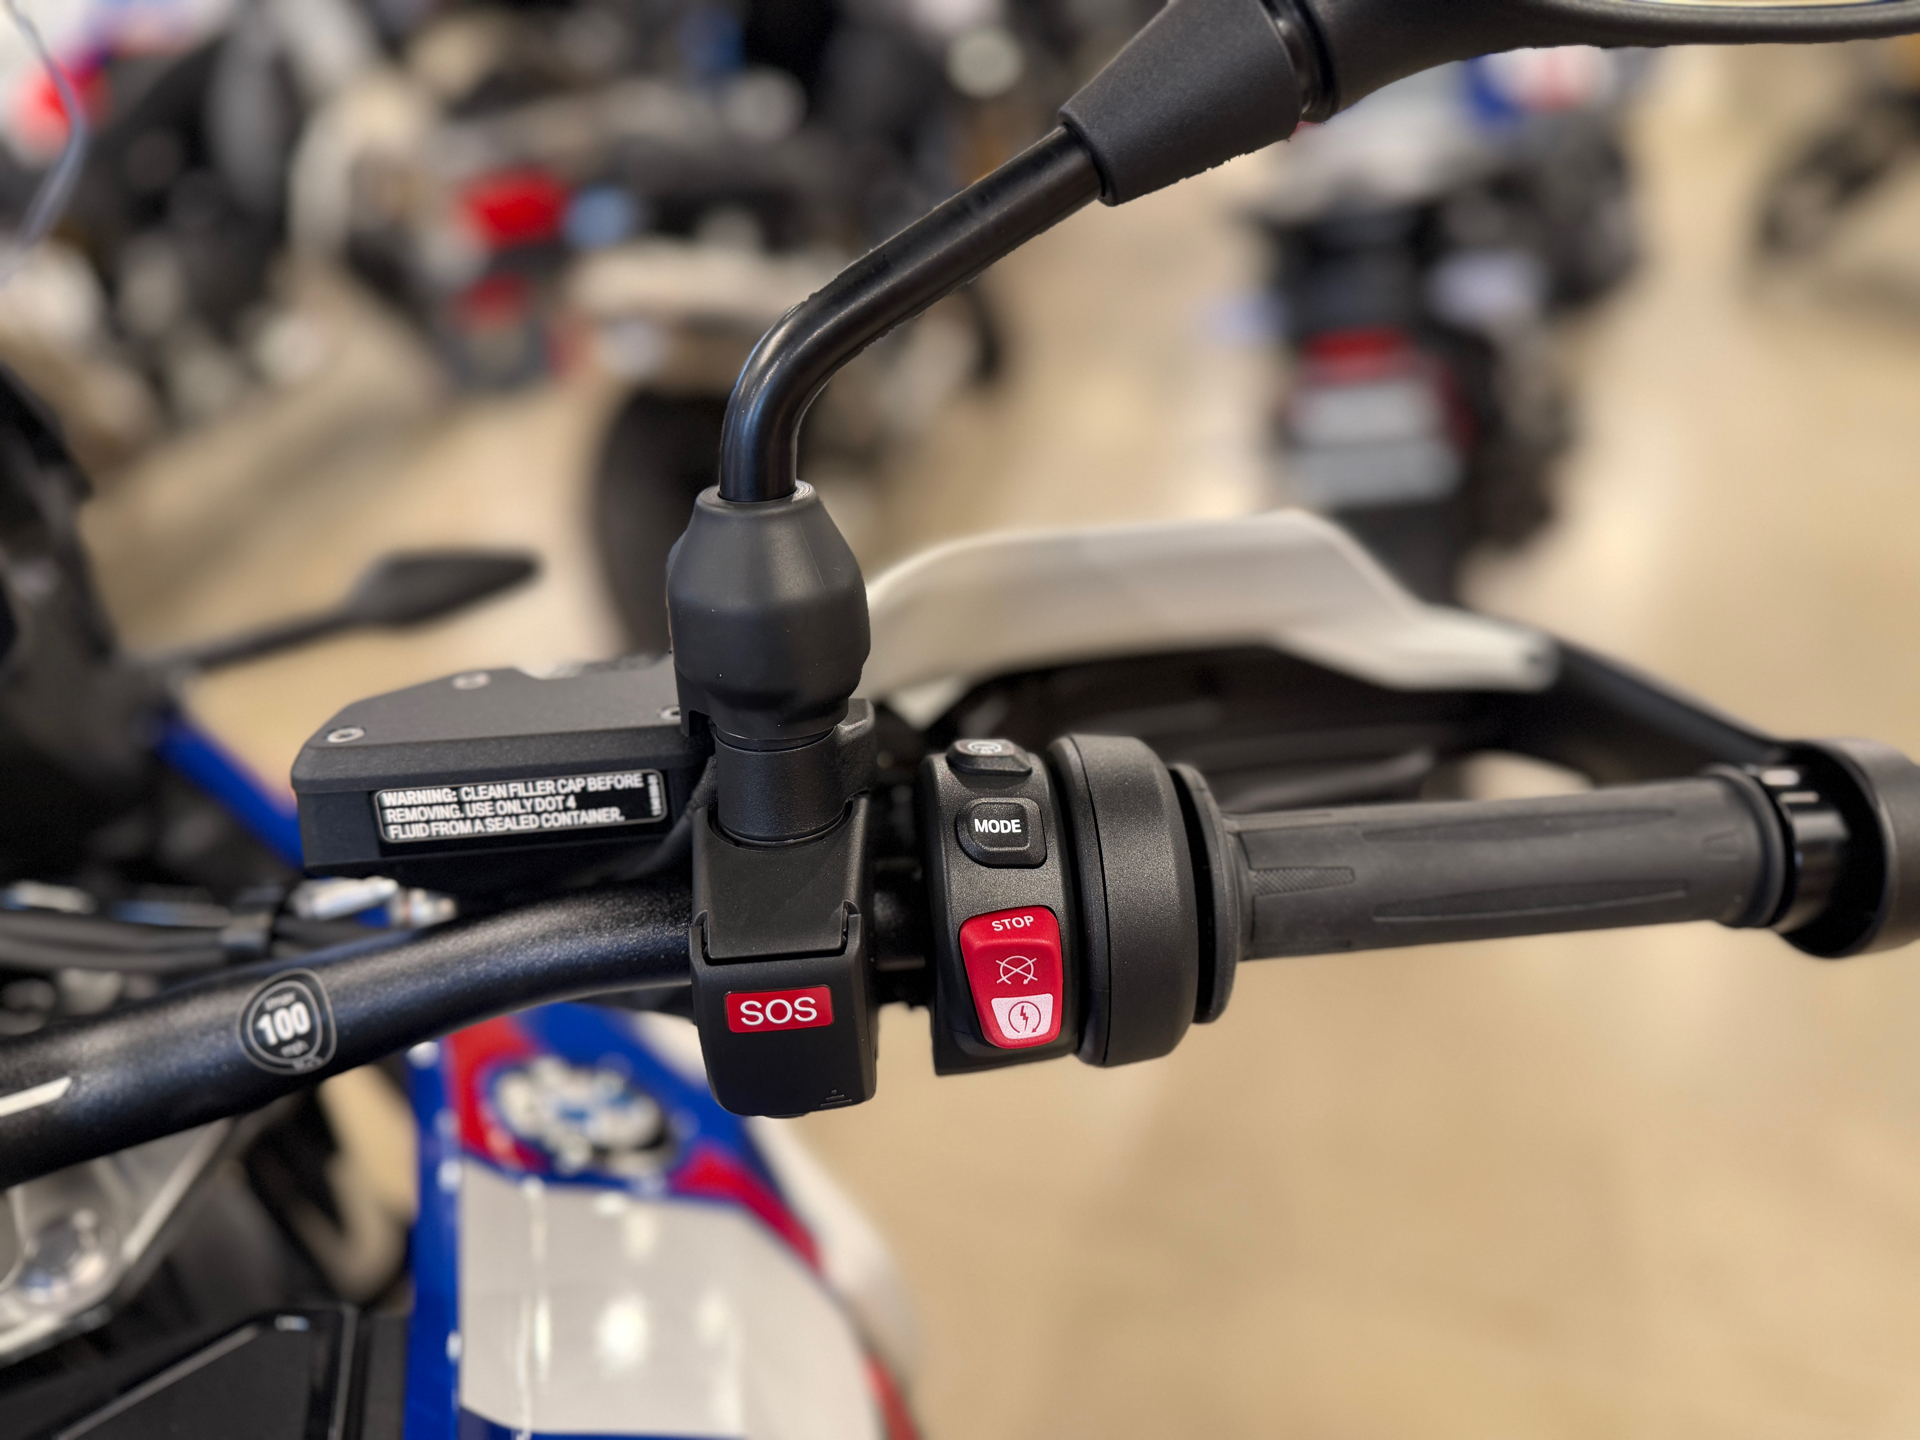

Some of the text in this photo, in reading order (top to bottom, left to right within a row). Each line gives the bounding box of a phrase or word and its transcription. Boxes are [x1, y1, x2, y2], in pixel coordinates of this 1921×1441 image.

[382, 773, 644, 806] WARNING: CLEAN FILLER CAP BEFORE
[385, 794, 577, 823] REMOVING. USE ONLY DOT 4
[388, 806, 625, 839] FLUID FROM A SEALED CONTAINER.
[974, 818, 1021, 833] MODE
[991, 915, 1034, 932] STOP
[256, 1001, 311, 1046] 100
[740, 997, 818, 1026] SOS
